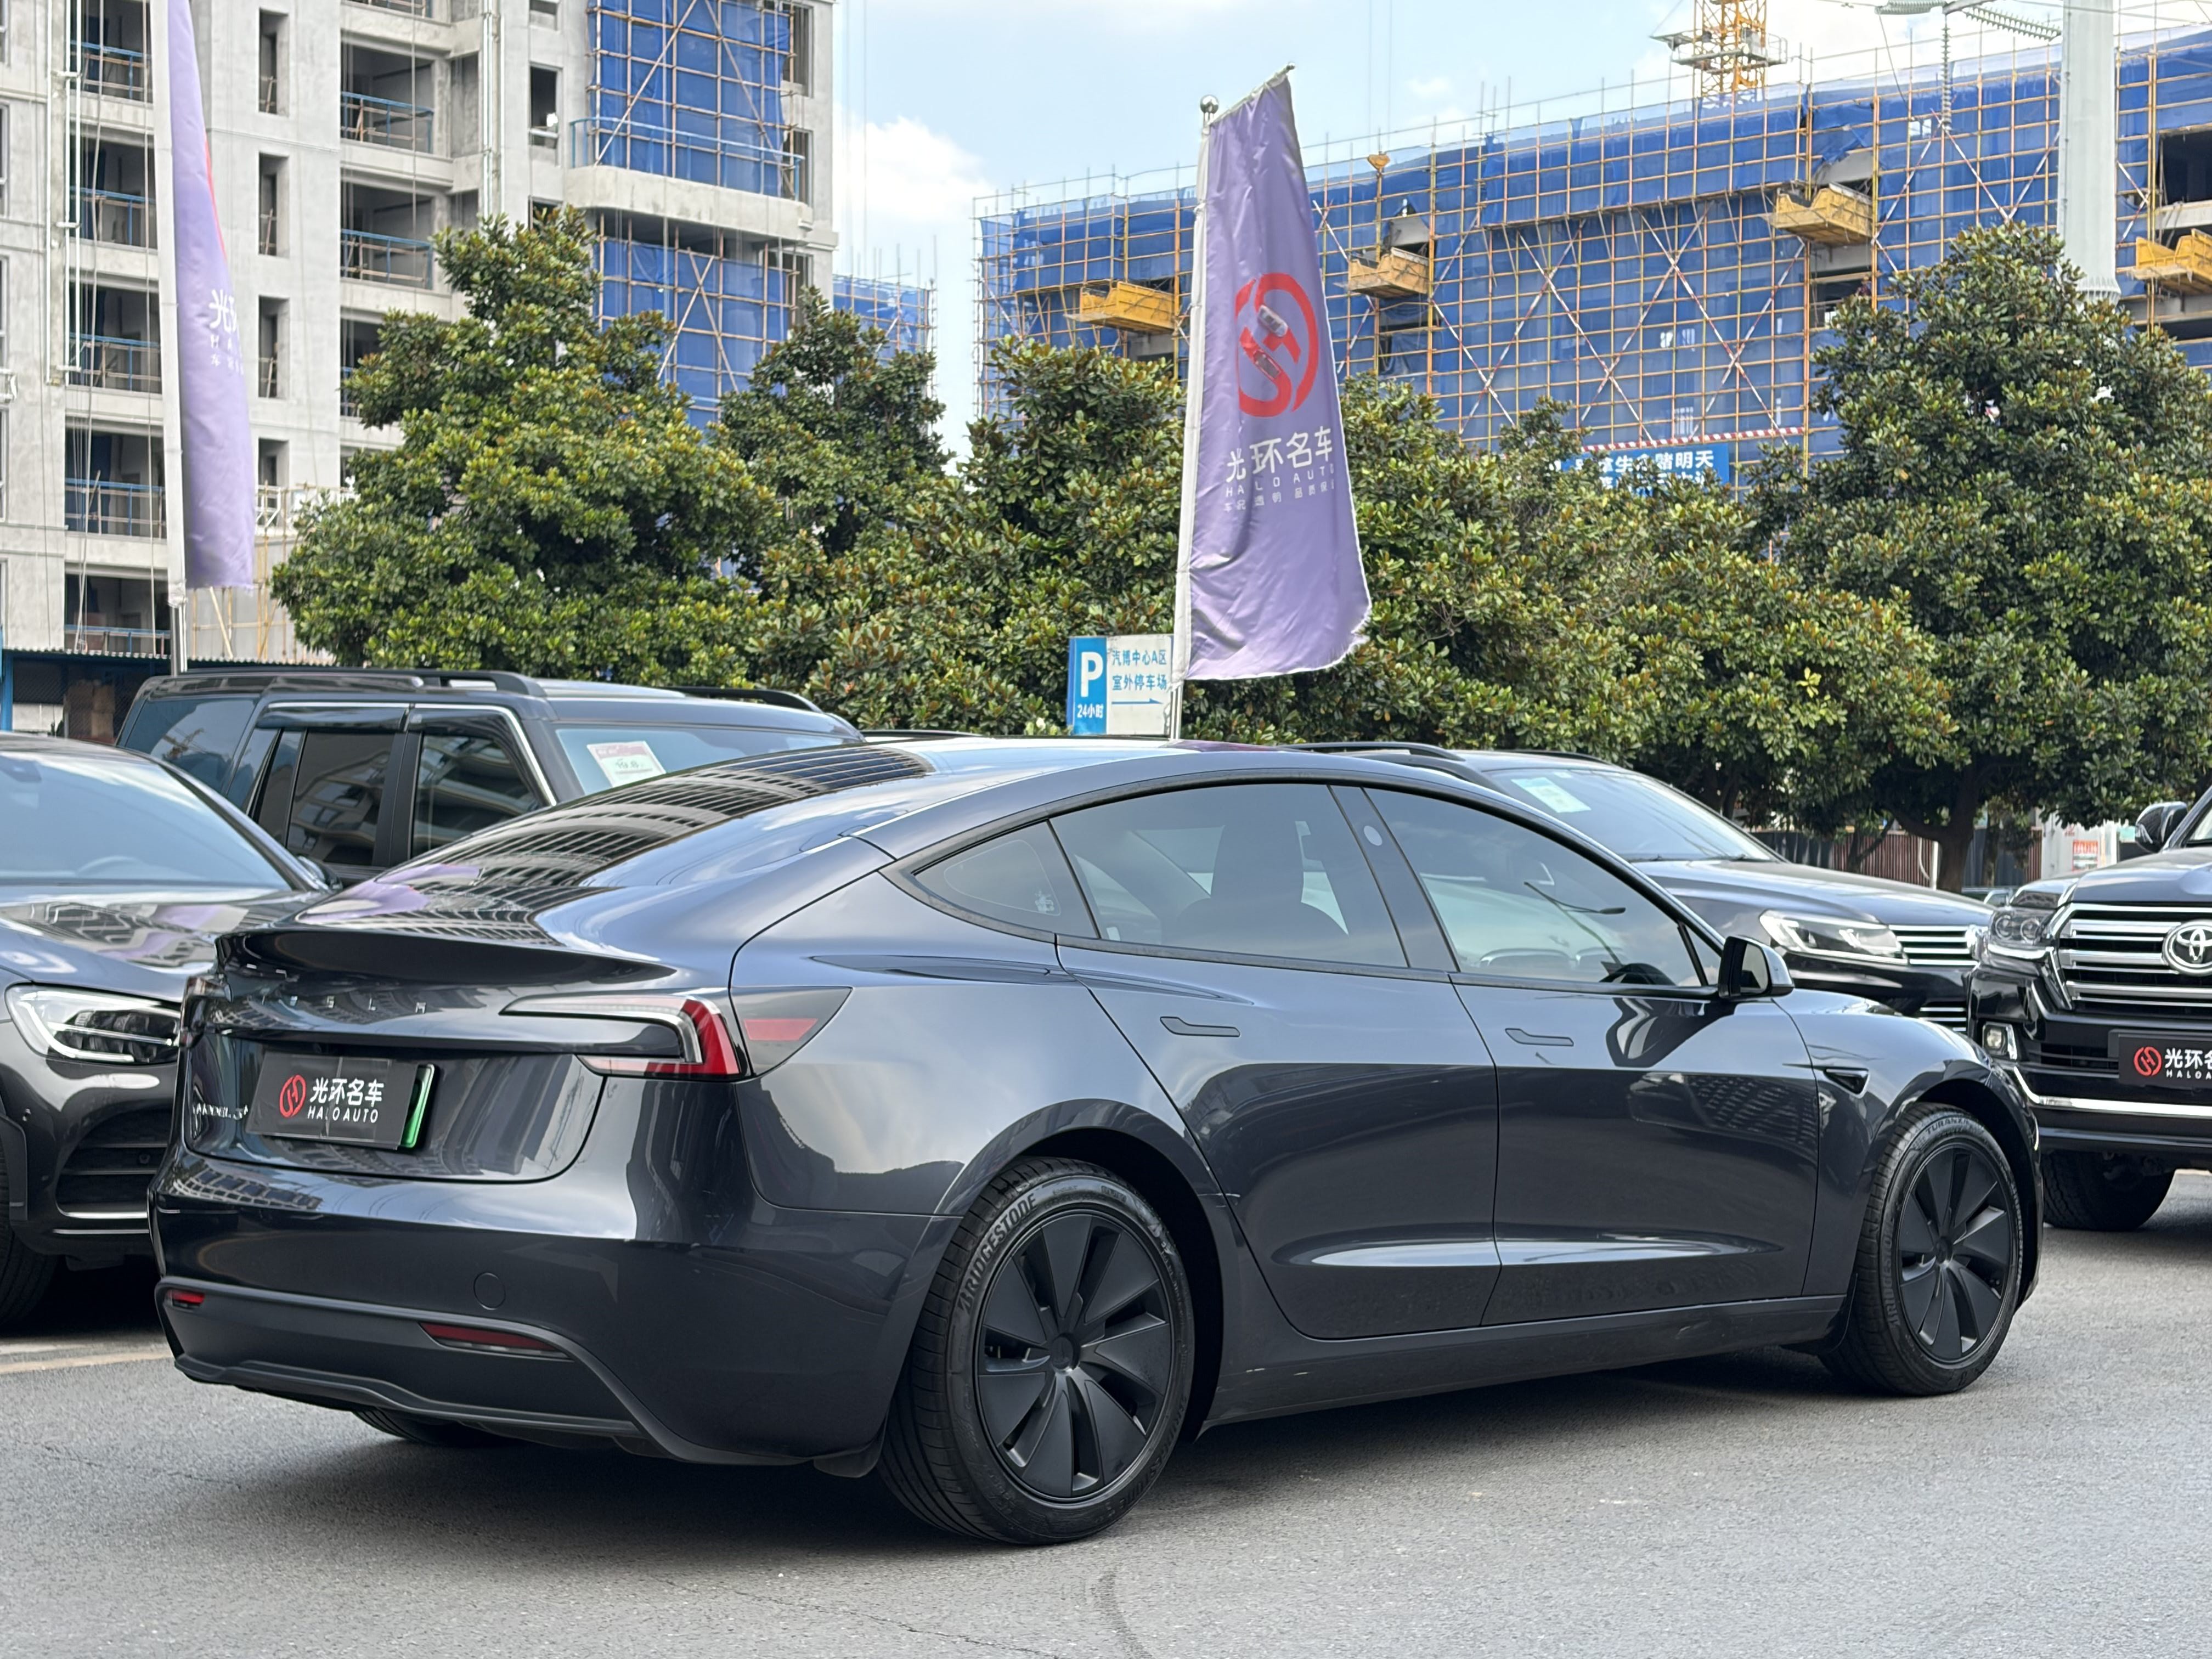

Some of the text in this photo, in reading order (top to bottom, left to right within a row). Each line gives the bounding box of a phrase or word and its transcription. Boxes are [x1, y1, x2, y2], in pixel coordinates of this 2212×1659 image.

[1226, 426, 1333, 483] 光环名车
[1080, 651, 1104, 698] P
[1112, 649, 1167, 667] 汽博中心A区
[1112, 674, 1167, 691] 室外停车场
[309, 1076, 385, 1108] 光环名车
[957, 1193, 1036, 1316] BRIDGESTONE
